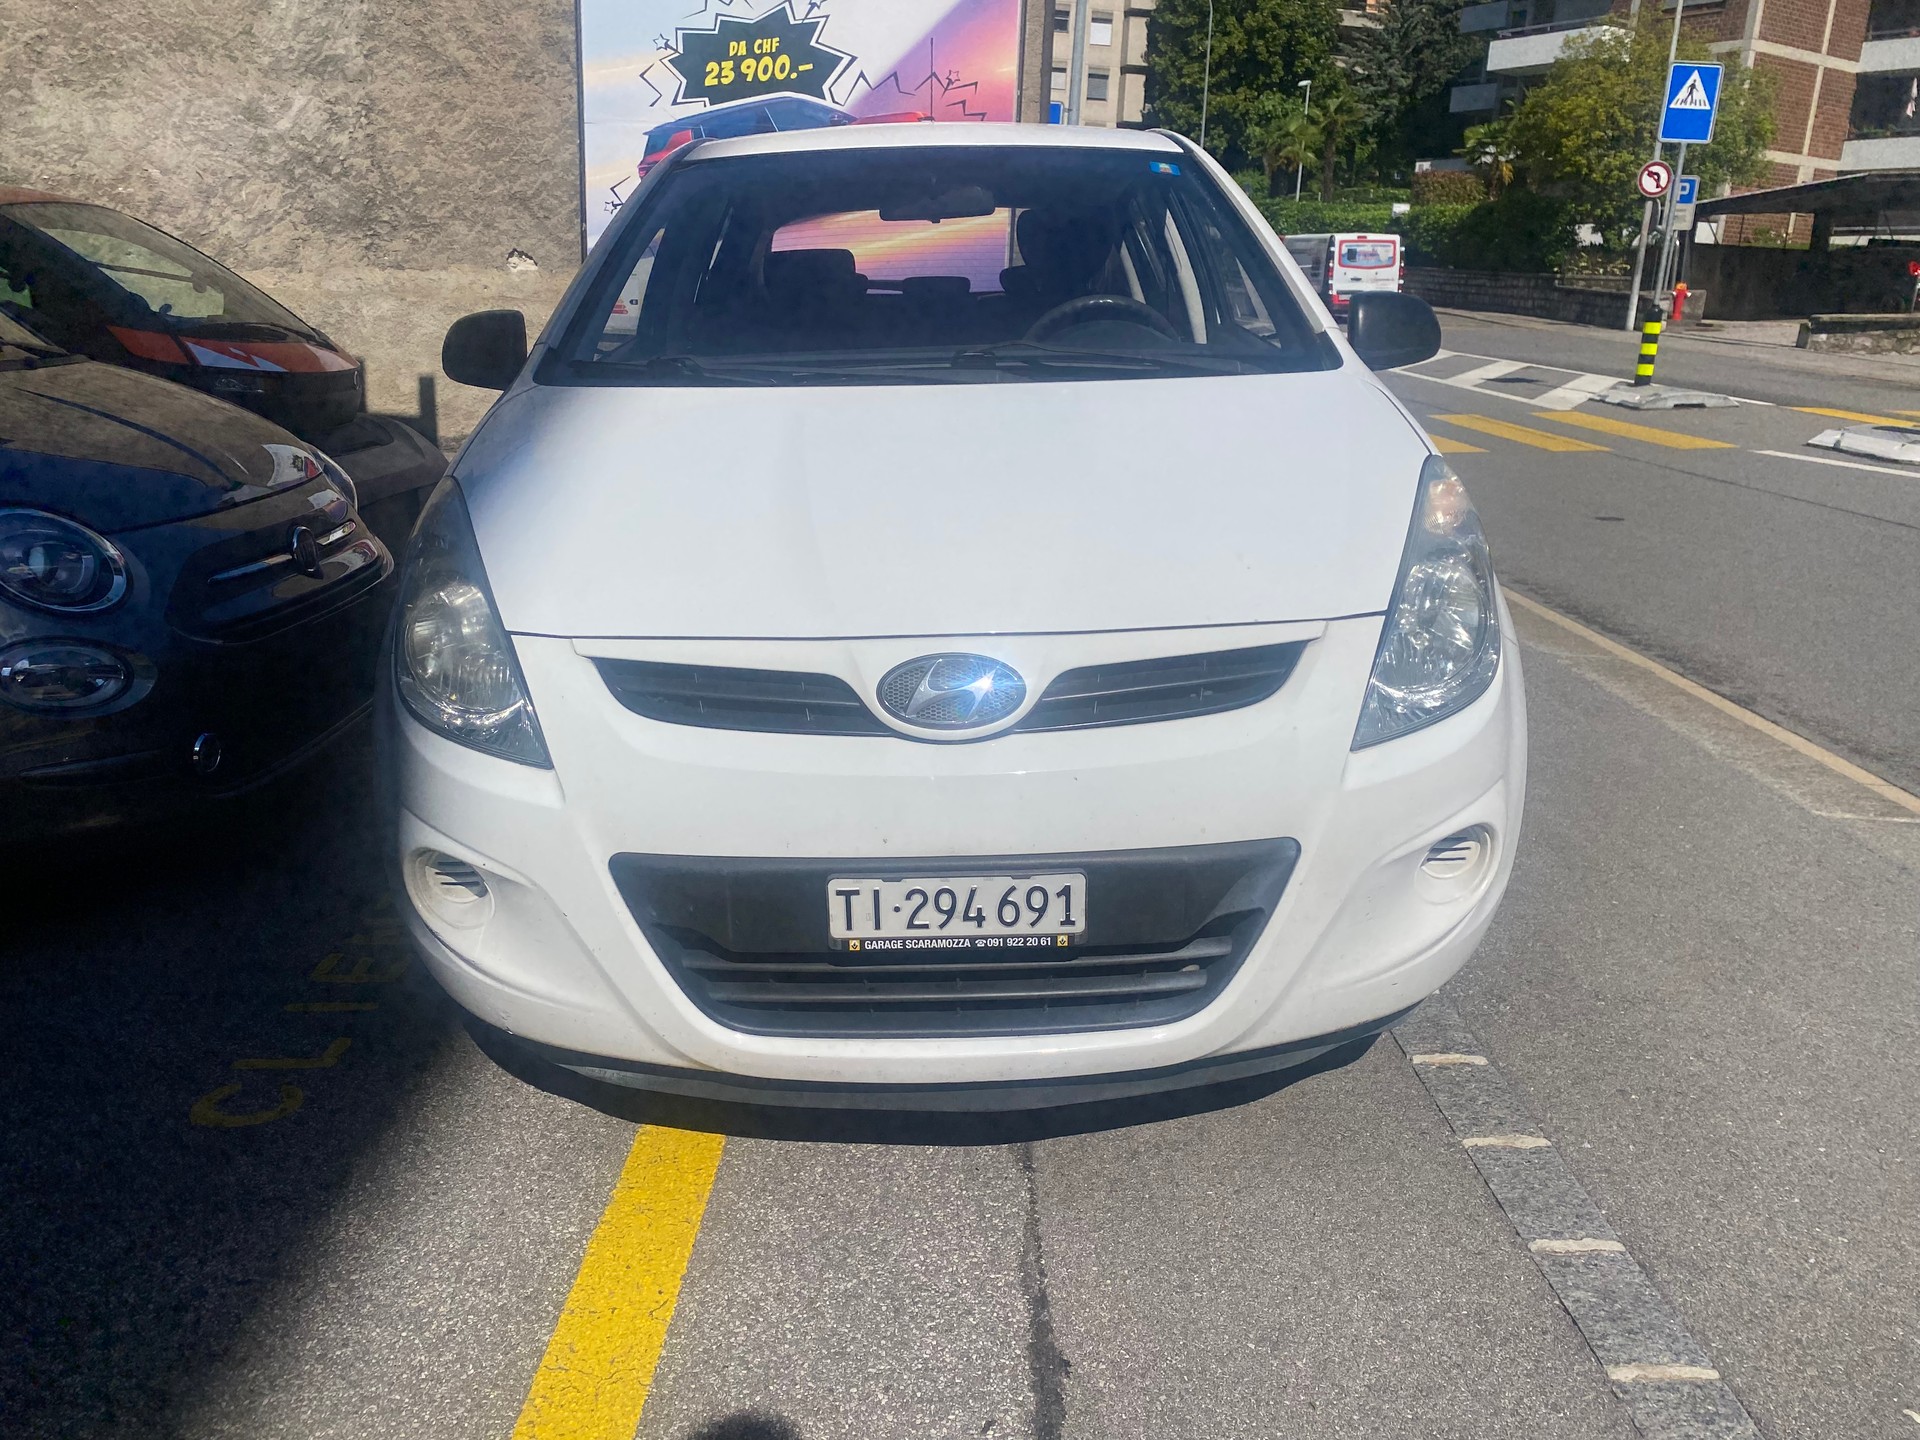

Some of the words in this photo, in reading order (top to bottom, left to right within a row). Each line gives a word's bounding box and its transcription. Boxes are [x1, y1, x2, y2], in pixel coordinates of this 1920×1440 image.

[729, 41, 747, 57] DA
[753, 37, 780, 54] CHF
[704, 60, 735, 87] 23
[1677, 182, 1691, 201] P
[864, 940, 904, 950] GARAGE
[905, 938, 971, 949] SCARAMOZZA
[986, 937, 1004, 947] 091
[1006, 937, 1024, 947] 922
[1026, 937, 1039, 946] 20
[1040, 936, 1052, 946] 61
